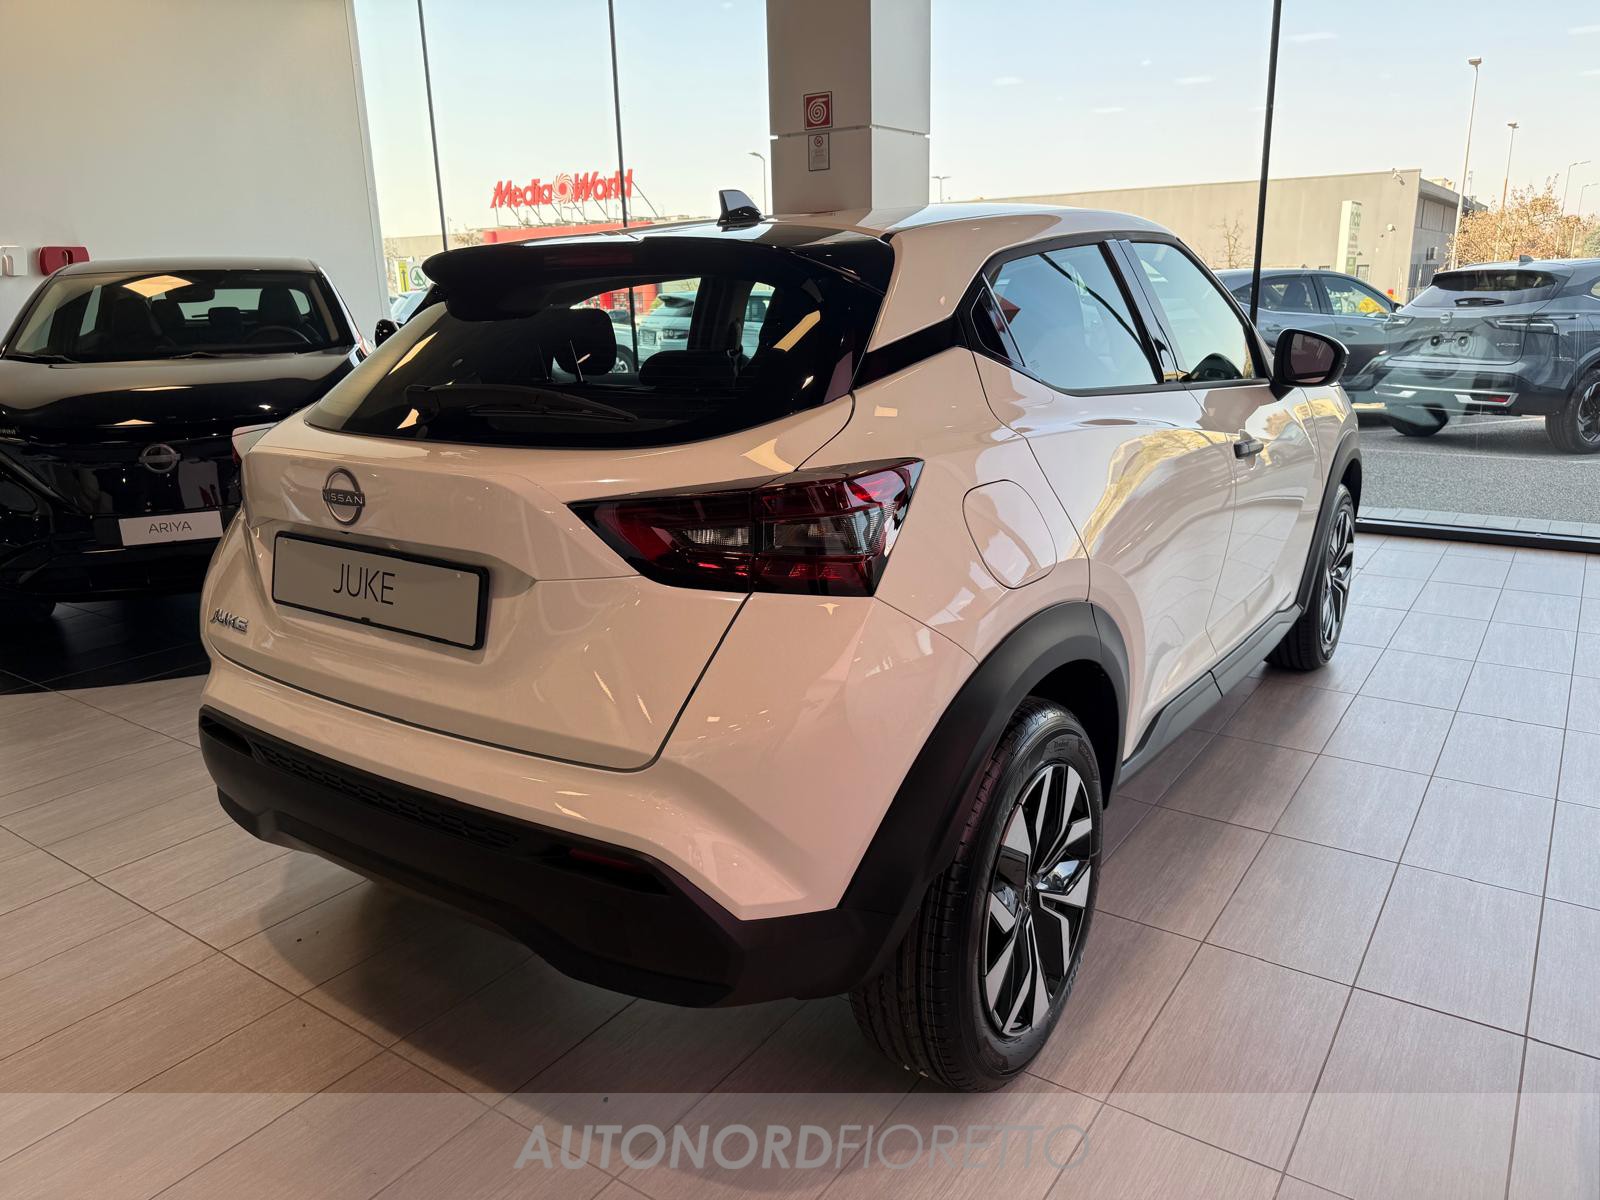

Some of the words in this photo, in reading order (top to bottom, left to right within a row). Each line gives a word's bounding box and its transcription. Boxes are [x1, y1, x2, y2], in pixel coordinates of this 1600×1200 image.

[490, 178, 553, 208] Media
[323, 489, 363, 505] NISSAN
[148, 519, 192, 535] ARIYA
[333, 563, 396, 606] JUKE
